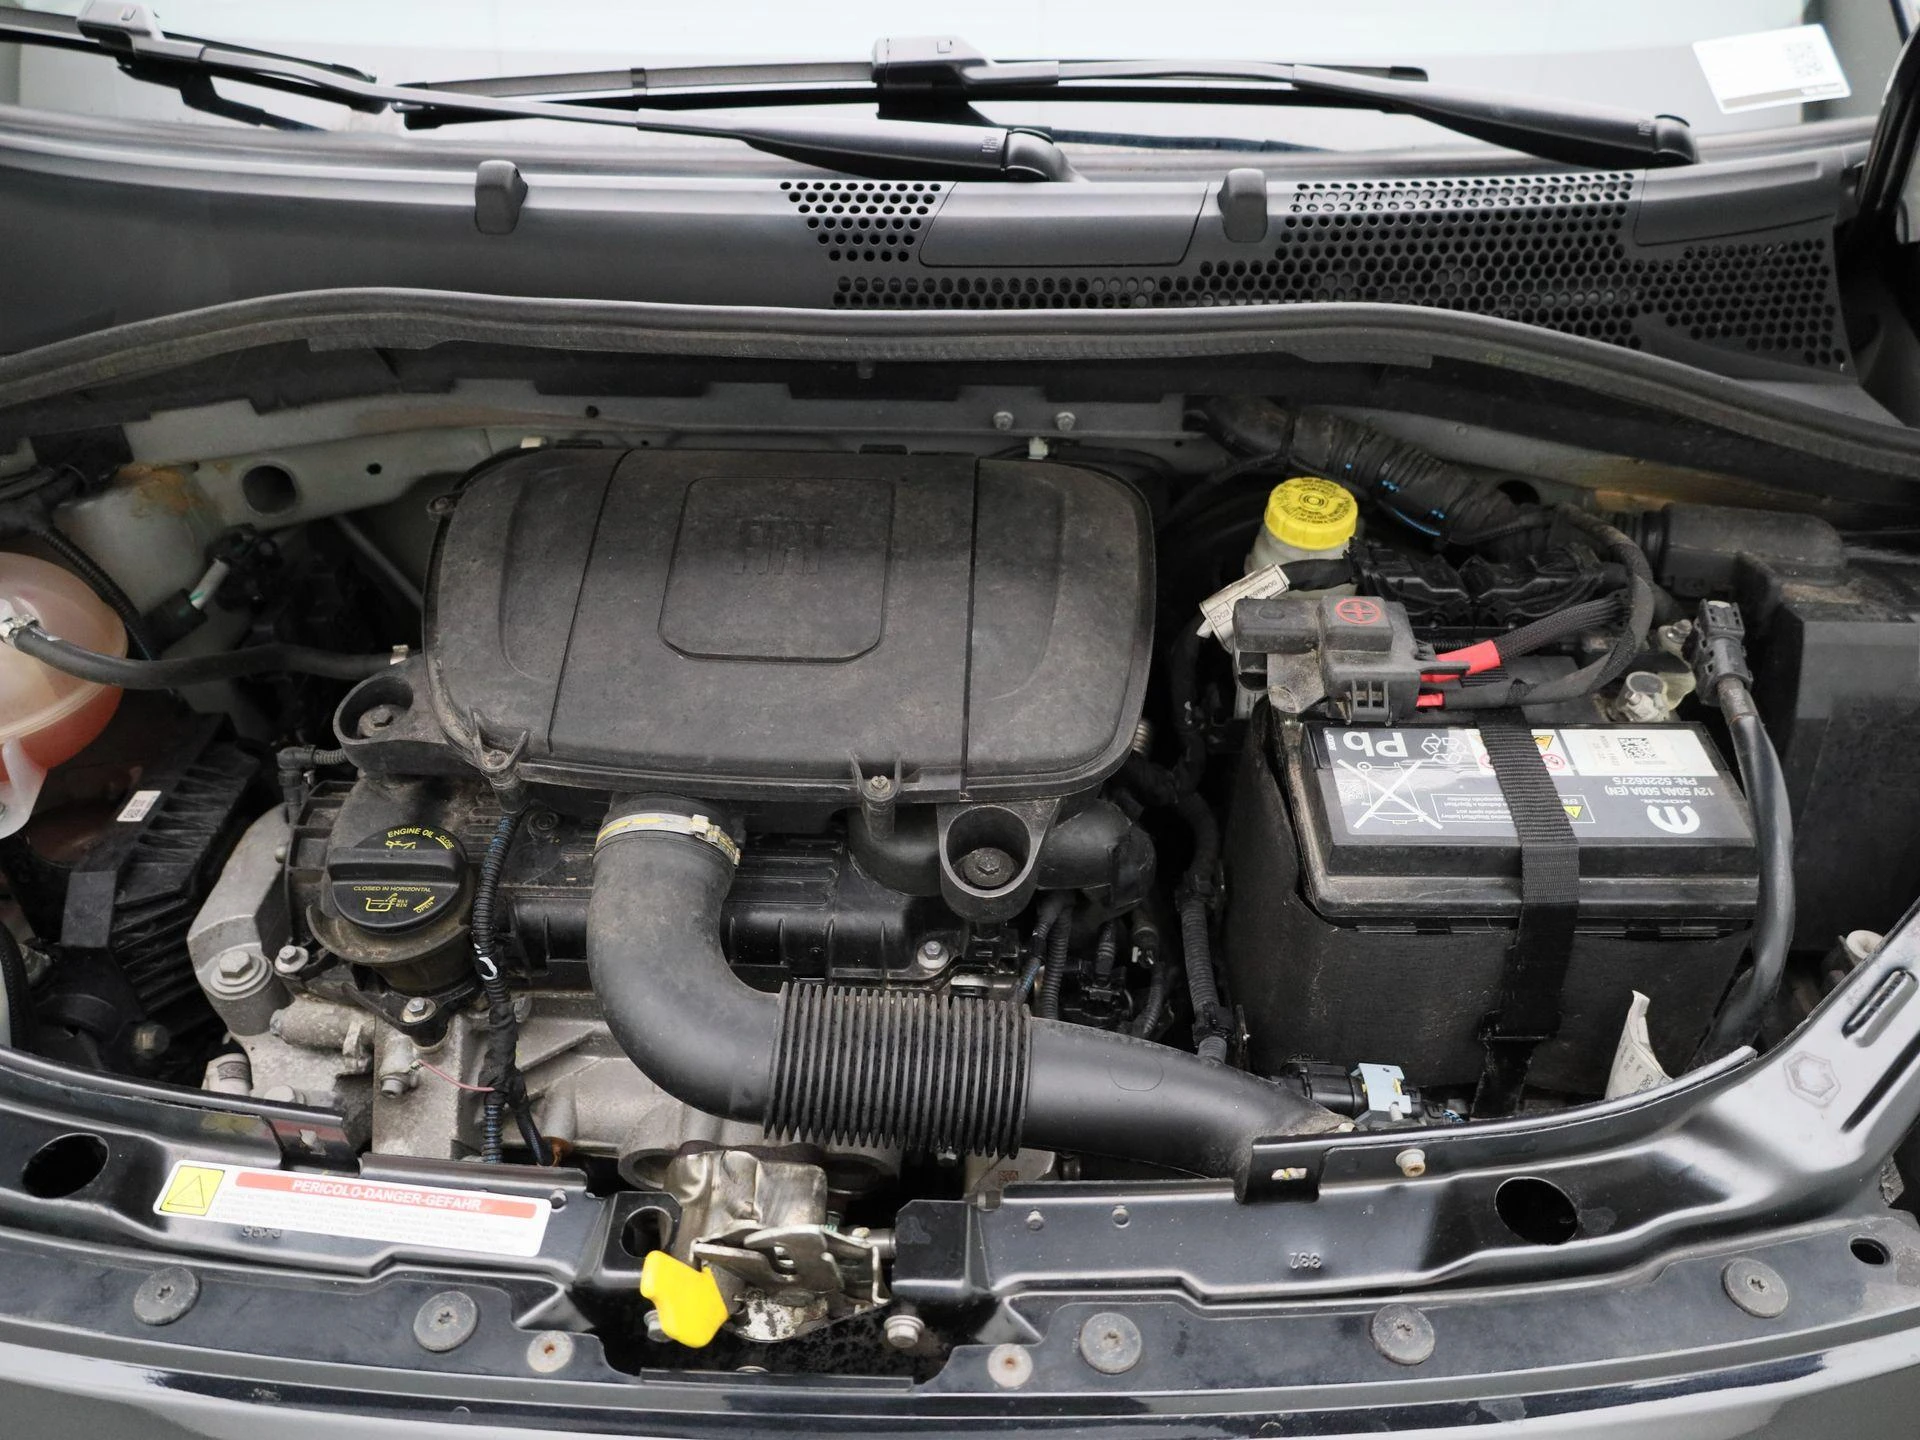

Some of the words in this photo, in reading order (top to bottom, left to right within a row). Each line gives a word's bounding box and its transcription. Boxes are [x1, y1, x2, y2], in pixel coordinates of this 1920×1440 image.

[1343, 731, 1408, 757] Pb
[1604, 785, 1629, 796] (EN)
[1629, 786, 1660, 796] 500A
[1662, 786, 1691, 796] 50Ah
[1693, 786, 1715, 796] 12V
[387, 827, 421, 839] ENGINE
[422, 829, 434, 839] OIL
[416, 901, 434, 913] OPEN
[291, 1178, 482, 1212] PERICOLO-DANGER-GEFAHR
